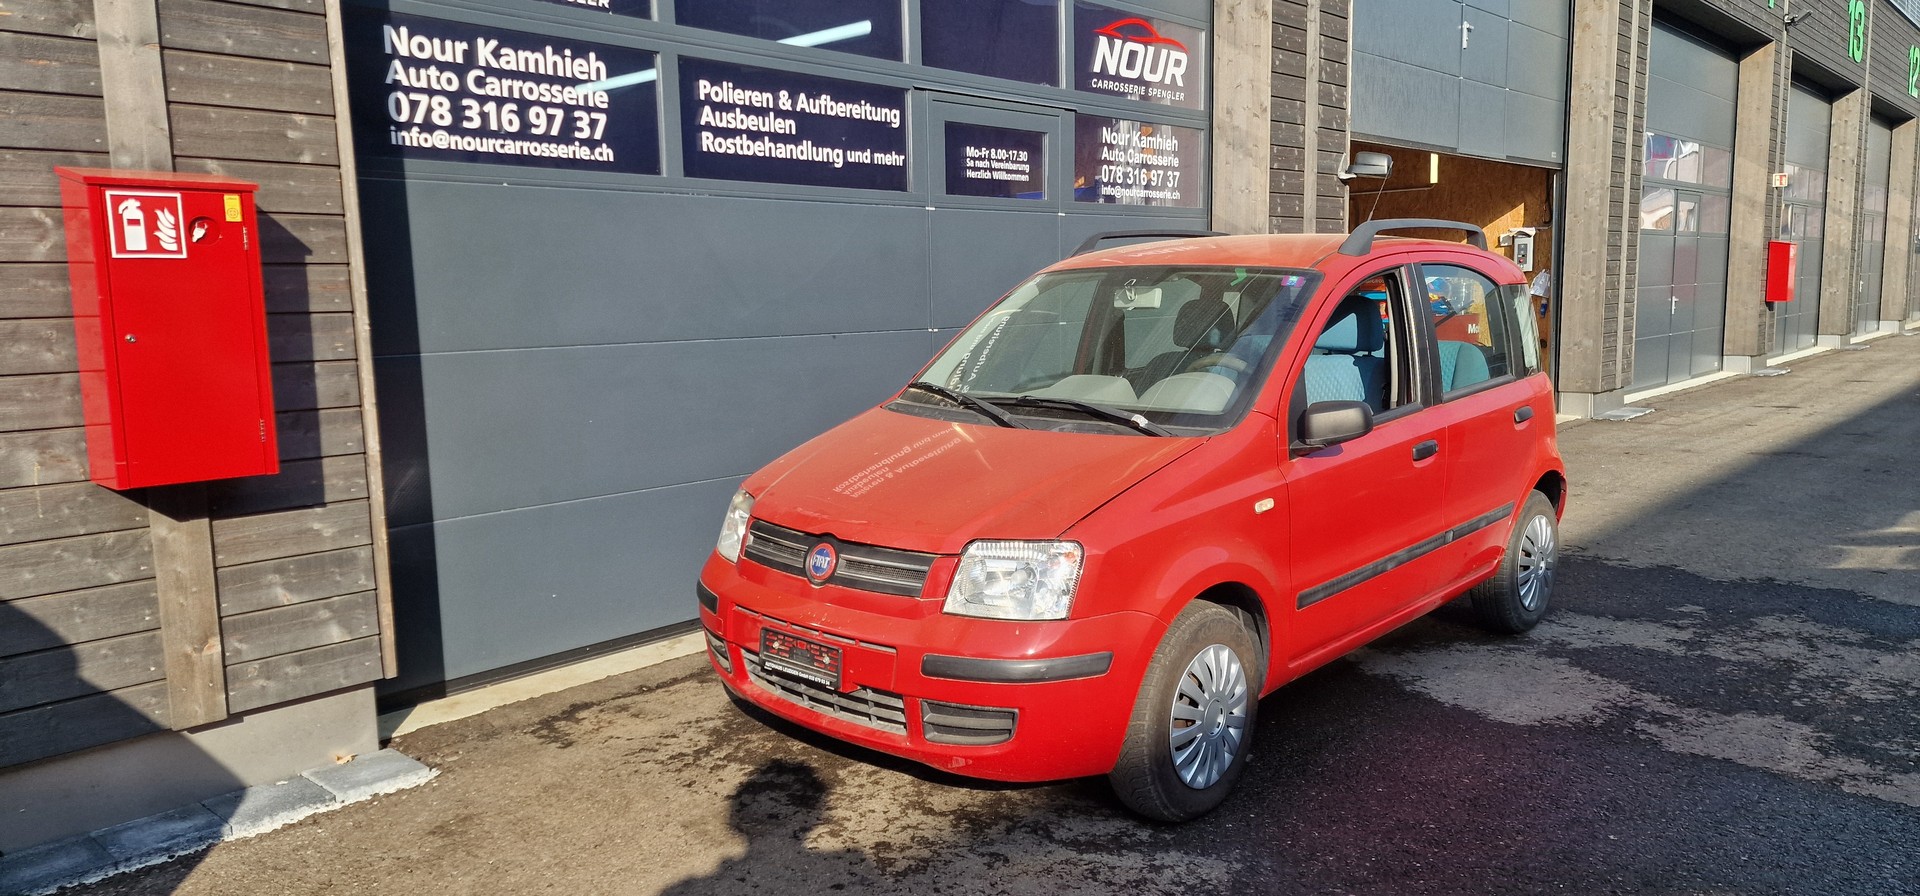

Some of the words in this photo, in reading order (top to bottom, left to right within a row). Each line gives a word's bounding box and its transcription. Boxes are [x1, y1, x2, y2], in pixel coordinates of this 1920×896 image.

[1848, 0, 1865, 62] 13
[383, 25, 468, 64] Nour
[476, 37, 607, 81] Kamhieh
[1093, 35, 1188, 87] NOUR
[385, 59, 459, 92] Auto
[467, 69, 609, 109] Carrosserie
[1908, 45, 1920, 99] 12
[699, 79, 773, 108] Polieren
[779, 90, 792, 111] &
[796, 93, 900, 128] Aufbereitung
[1091, 78, 1146, 95] CARROSSERIE
[1148, 88, 1185, 101] SPENGLER
[388, 91, 452, 126] 078
[461, 98, 520, 133] 316
[528, 106, 564, 136] 97
[573, 111, 607, 140] 37
[700, 105, 796, 135] Ausbeulen
[390, 126, 614, 162] info@nourcarrosserie.ch
[701, 131, 843, 168] Rostbehandlung
[847, 149, 870, 163] und
[873, 151, 905, 166] mehr
[966, 146, 989, 158] Mo-Fr
[990, 148, 1028, 162] 8.00-17.30
[1102, 127, 1130, 146] Nour
[1133, 131, 1178, 151] Kamhieh
[966, 158, 974, 167] Sa
[975, 159, 990, 168] nach
[990, 160, 1030, 173] Vereinbarung
[1101, 146, 1124, 162] Auto
[1127, 149, 1179, 167] Carrosserie
[966, 169, 991, 179] Herzlich
[992, 171, 1030, 182] Willkommen
[1101, 164, 1124, 183] 078
[1127, 167, 1148, 186] 316
[1151, 169, 1164, 186] 97
[1167, 171, 1180, 188] 37
[1101, 185, 1181, 200] info@nourcarrosserie.ch
[812, 554, 830, 569] FIAT
